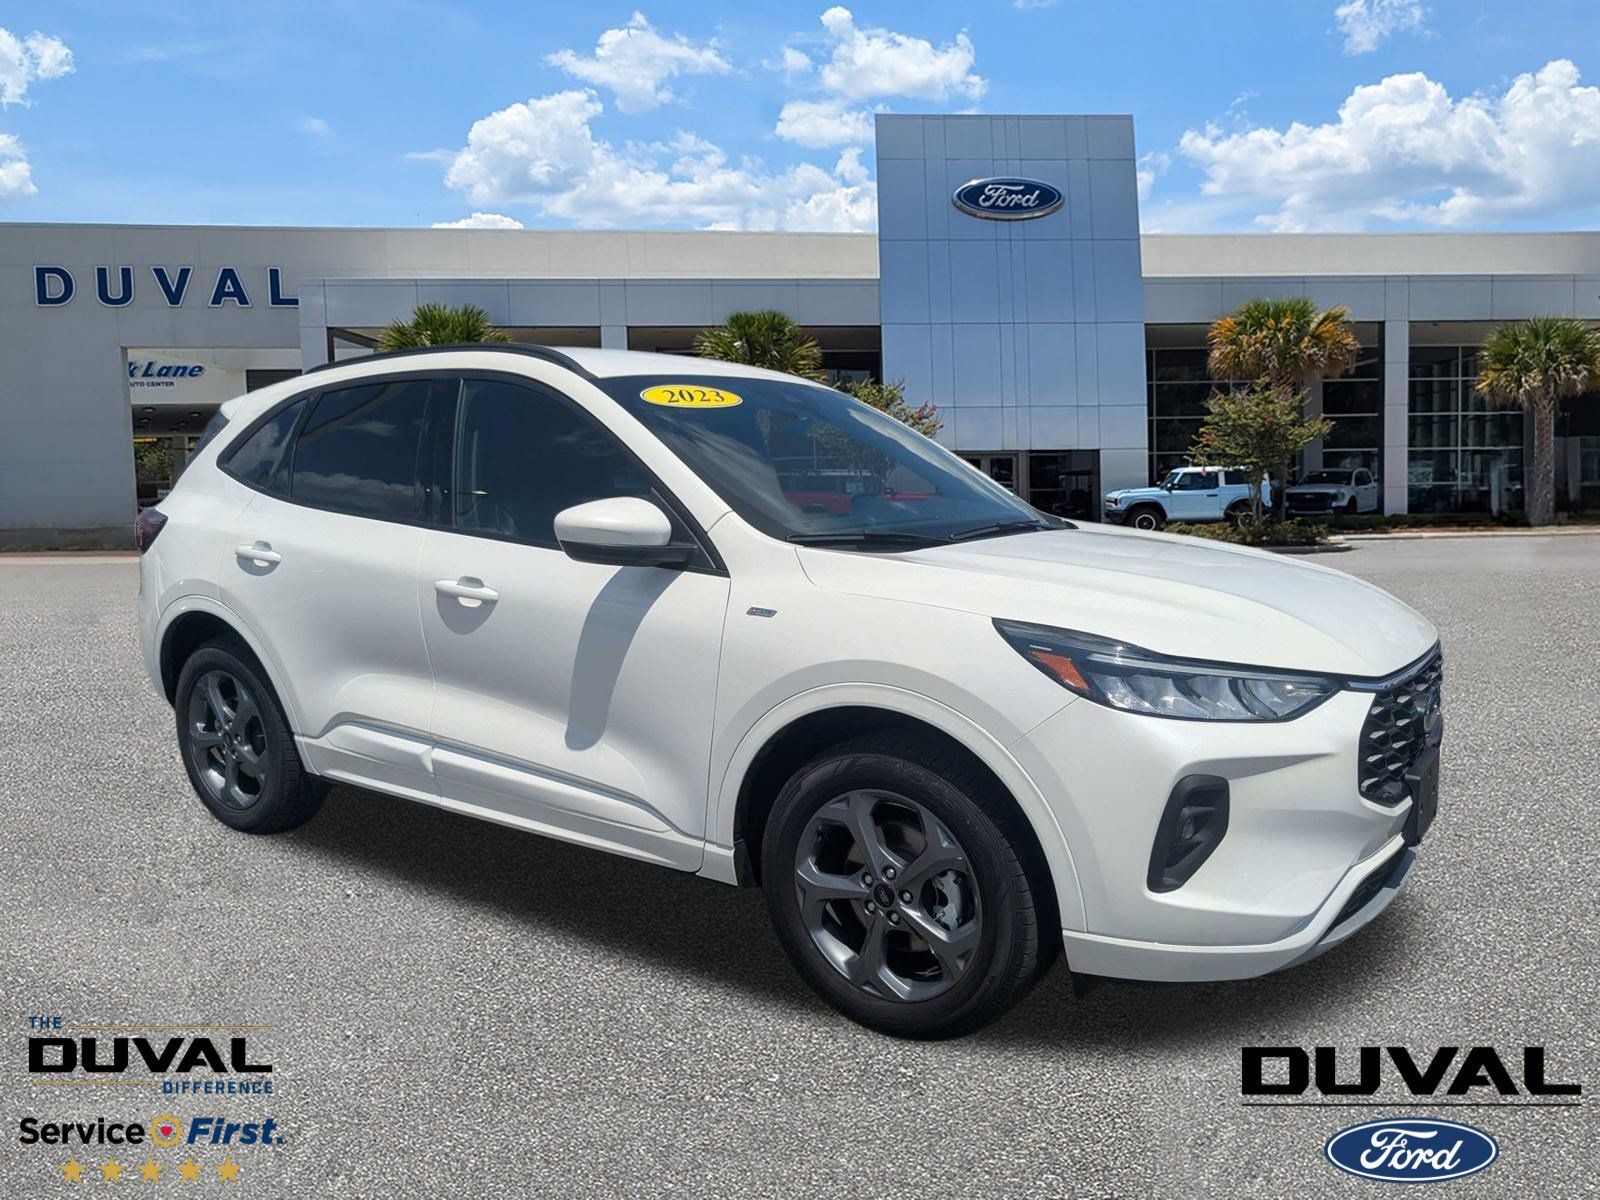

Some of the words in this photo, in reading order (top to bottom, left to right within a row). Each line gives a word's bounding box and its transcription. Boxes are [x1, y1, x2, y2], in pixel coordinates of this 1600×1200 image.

[978, 184, 1041, 207] Ford
[33, 265, 299, 308] DUVAL
[141, 361, 205, 378] Lane
[662, 389, 725, 403] 2023
